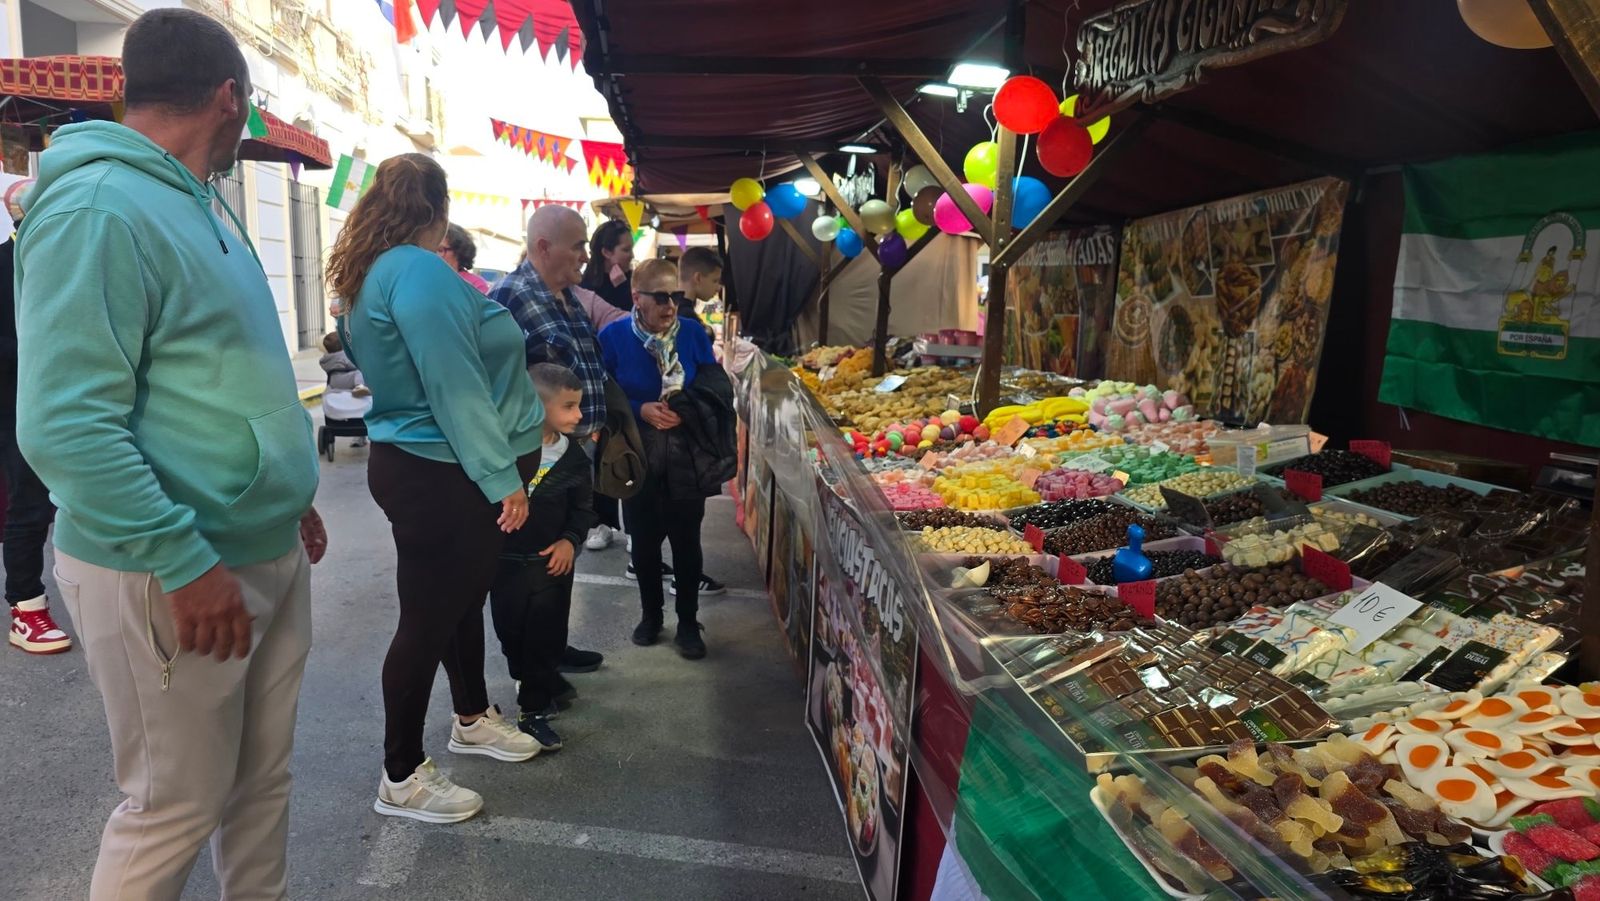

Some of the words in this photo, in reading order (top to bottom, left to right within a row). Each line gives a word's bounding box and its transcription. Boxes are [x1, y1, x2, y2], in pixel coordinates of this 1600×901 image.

[1509, 333, 1525, 342] POR
[1525, 333, 1553, 344] ESPAÑA
[1464, 652, 1489, 665] DUBAI
[1064, 681, 1086, 704] DUBAI
